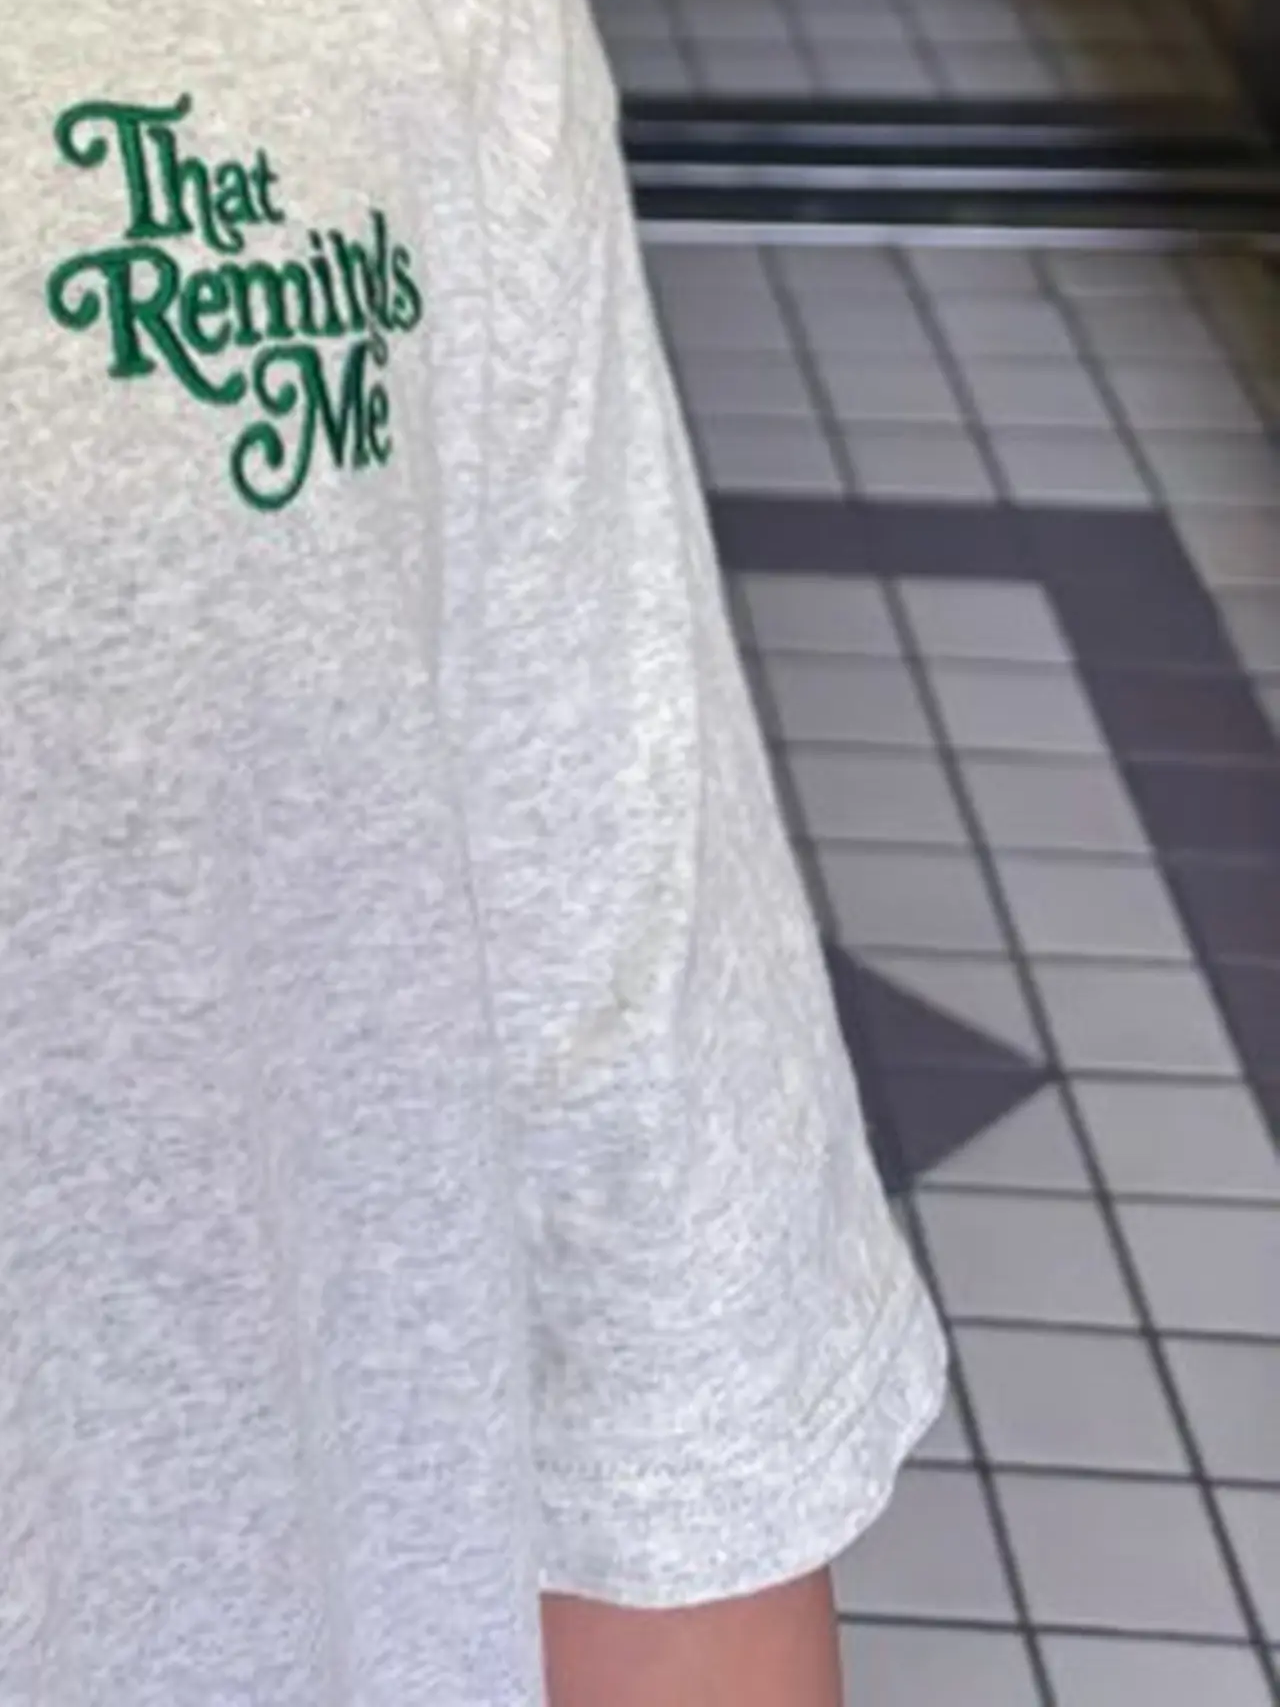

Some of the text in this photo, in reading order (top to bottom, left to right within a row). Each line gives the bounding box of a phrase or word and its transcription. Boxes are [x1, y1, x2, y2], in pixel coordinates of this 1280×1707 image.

[54, 92, 285, 255] That
[47, 208, 423, 405] Reminds
[230, 340, 393, 512] Me
